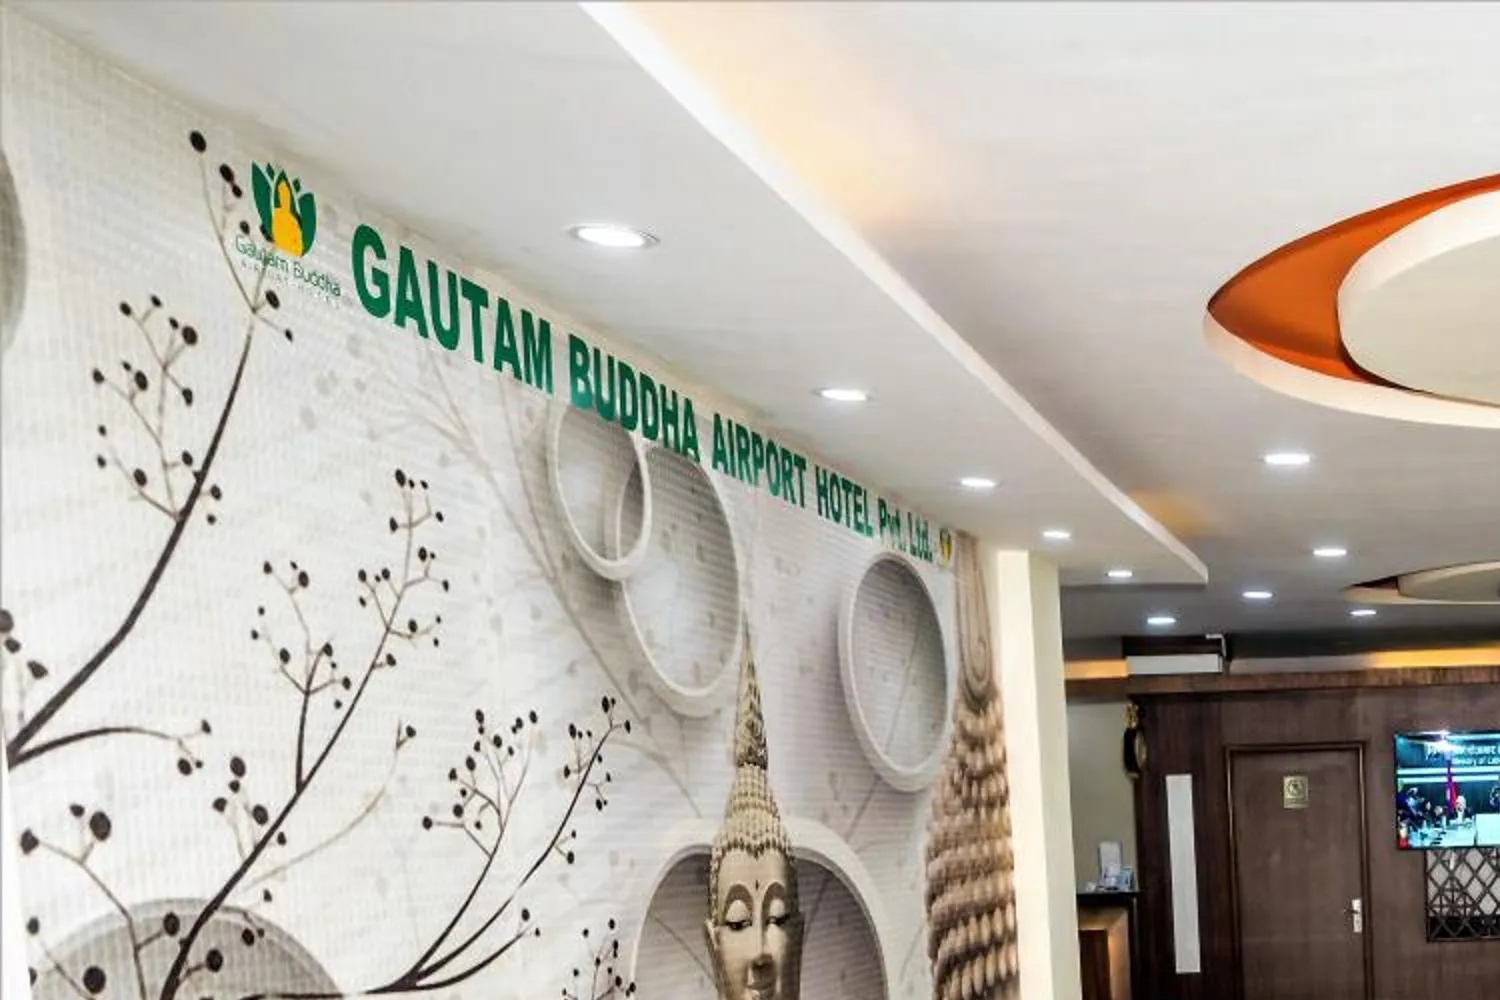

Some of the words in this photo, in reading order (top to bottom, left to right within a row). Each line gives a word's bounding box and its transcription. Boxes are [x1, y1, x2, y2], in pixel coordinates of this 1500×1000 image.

[293, 260, 341, 297] Buddha
[351, 223, 554, 395] GAUTAM
[568, 333, 701, 464] BUDDHA
[711, 412, 808, 509] AIRPORT
[815, 463, 874, 539] HOTEL
[877, 497, 906, 553] Pvt.
[907, 511, 933, 562] Ltd.
